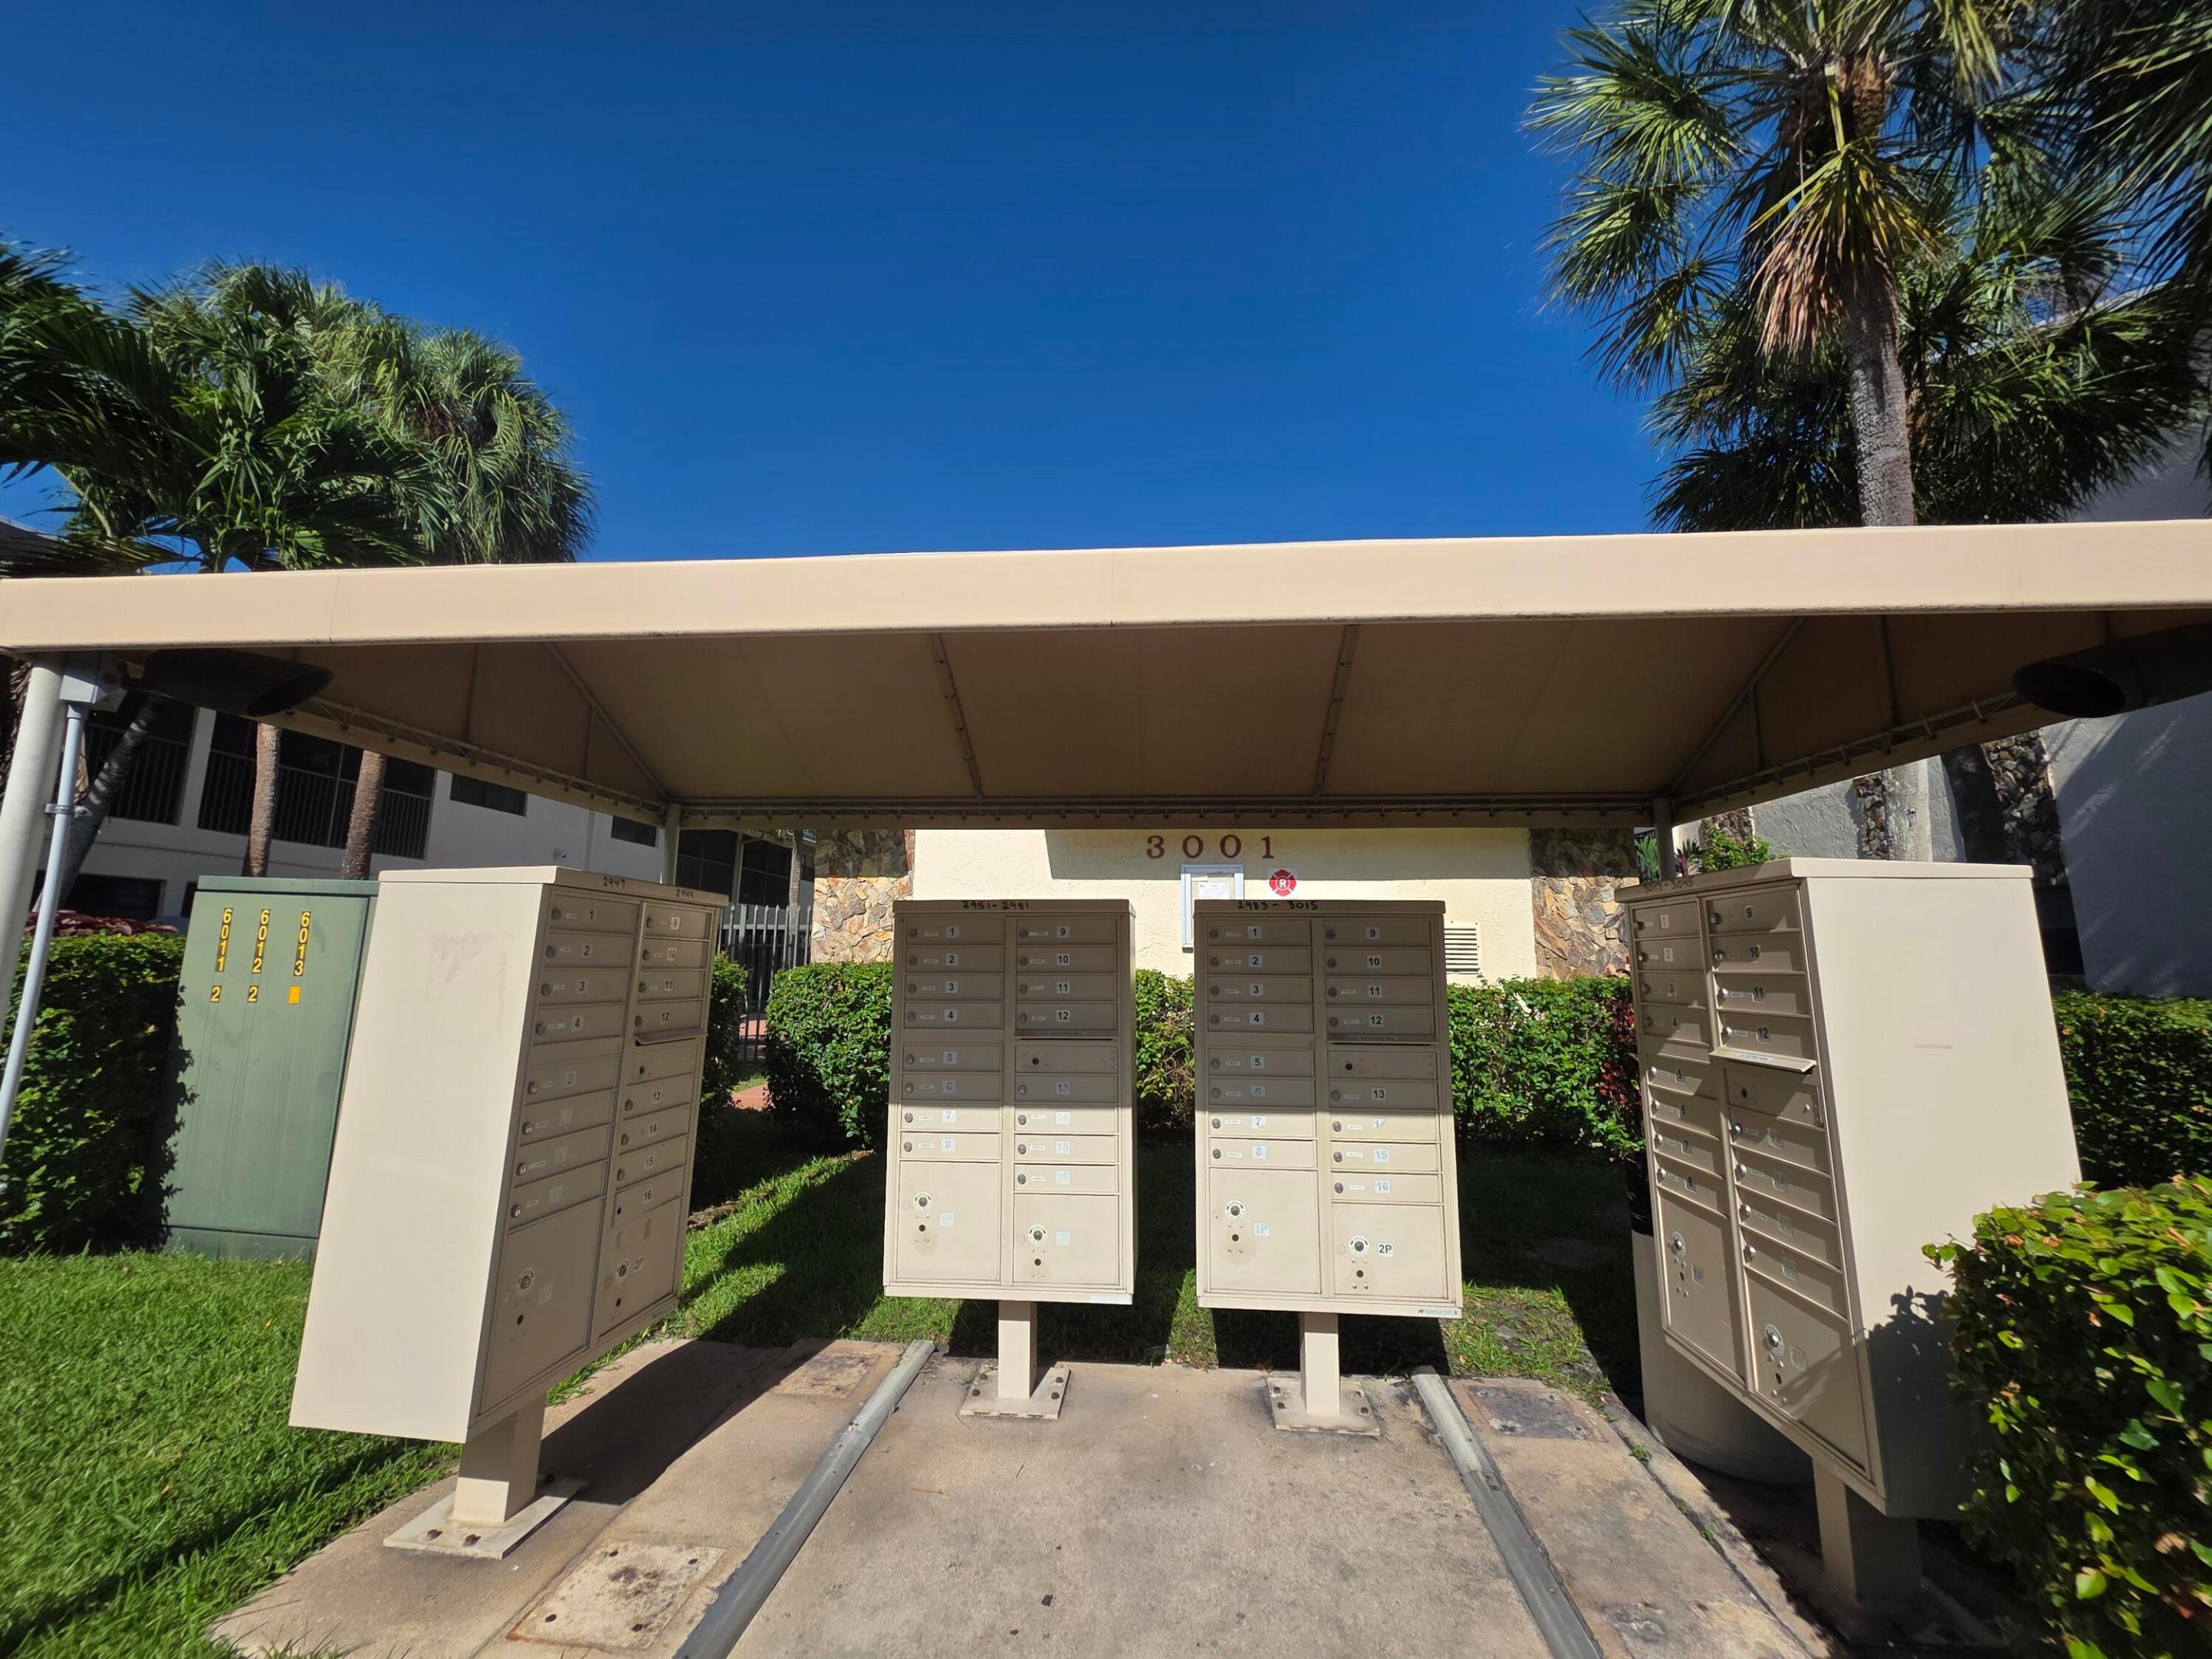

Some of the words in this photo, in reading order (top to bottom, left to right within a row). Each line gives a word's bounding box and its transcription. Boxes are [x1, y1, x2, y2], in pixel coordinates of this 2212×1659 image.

[1146, 834, 1273, 859] 3001
[1280, 879, 1286, 888] R
[1287, 900, 1319, 910] 3015
[590, 910, 593, 920] 1
[1747, 908, 1752, 918] 9
[673, 919, 677, 927] 9
[217, 909, 233, 971] 6011
[253, 909, 270, 973] 6012
[294, 912, 310, 975] 6013
[584, 945, 589, 955] 2
[668, 949, 676, 959] 10
[1665, 949, 1671, 960] 2
[1750, 946, 1759, 958] 10
[580, 982, 584, 991] 3
[665, 980, 672, 988] 11
[1670, 984, 1674, 993] 3
[210, 986, 220, 1002] 2
[1253, 985, 1259, 994] 3
[1370, 987, 1379, 995] 11
[1754, 988, 1763, 998] 11
[248, 987, 258, 1002] 2
[662, 1012, 669, 1021] 12
[1058, 1012, 1068, 1020] 12
[1371, 1016, 1382, 1025] 12
[575, 1018, 580, 1028] 4
[1673, 1017, 1677, 1026] 4
[1759, 1028, 1768, 1038] 12
[1255, 1058, 1260, 1066] 5
[1677, 1069, 1682, 1079] 5
[946, 1082, 952, 1091] 6
[654, 1091, 661, 1100] 13
[1373, 1090, 1385, 1098] 13
[1681, 1104, 1686, 1115] 6
[946, 1111, 951, 1119] 7
[1255, 1118, 1262, 1126] 7
[650, 1124, 657, 1134] 14
[1684, 1140, 1689, 1150] 7
[1257, 1147, 1262, 1156] 8
[1376, 1151, 1387, 1159] 15
[645, 1157, 654, 1167] 15
[1376, 1182, 1388, 1190] 16
[644, 1190, 651, 1200] 16
[1255, 1224, 1267, 1233] 1P
[1379, 1244, 1392, 1253] 2P
